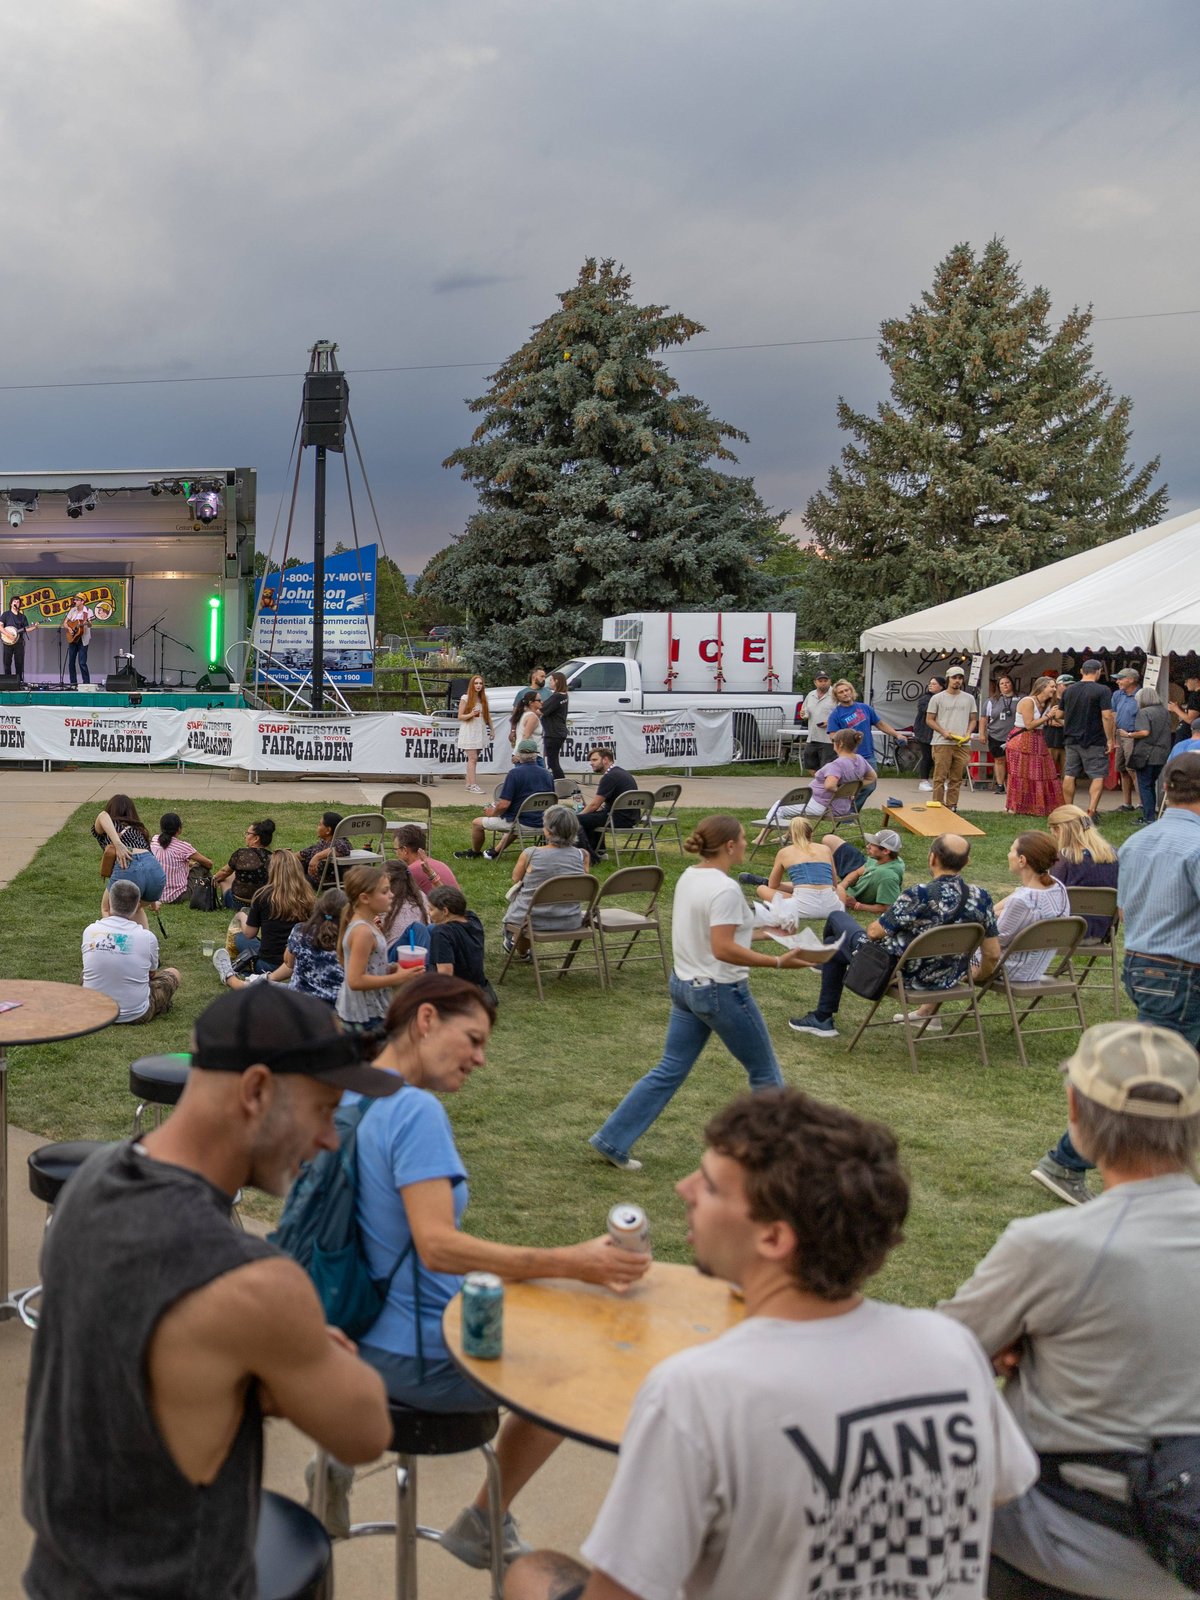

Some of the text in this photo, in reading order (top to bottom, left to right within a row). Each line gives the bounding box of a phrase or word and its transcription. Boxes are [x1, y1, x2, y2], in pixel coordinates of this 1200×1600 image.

[276, 586, 346, 600] Johnon
[260, 617, 306, 625] Resdential
[323, 617, 368, 625] ommercial
[670, 635, 767, 664] ICE
[64, 718, 93, 728] STAPP
[258, 723, 290, 734] STAPP
[400, 726, 433, 737] STAPP
[69, 728, 152, 754] FAIR GARDEN
[261, 735, 354, 762] FAIR GARDEN
[405, 738, 494, 763] FAIR GAREN
[645, 734, 698, 758] FAIR GARDEN
[783, 1390, 979, 1501] VANS
